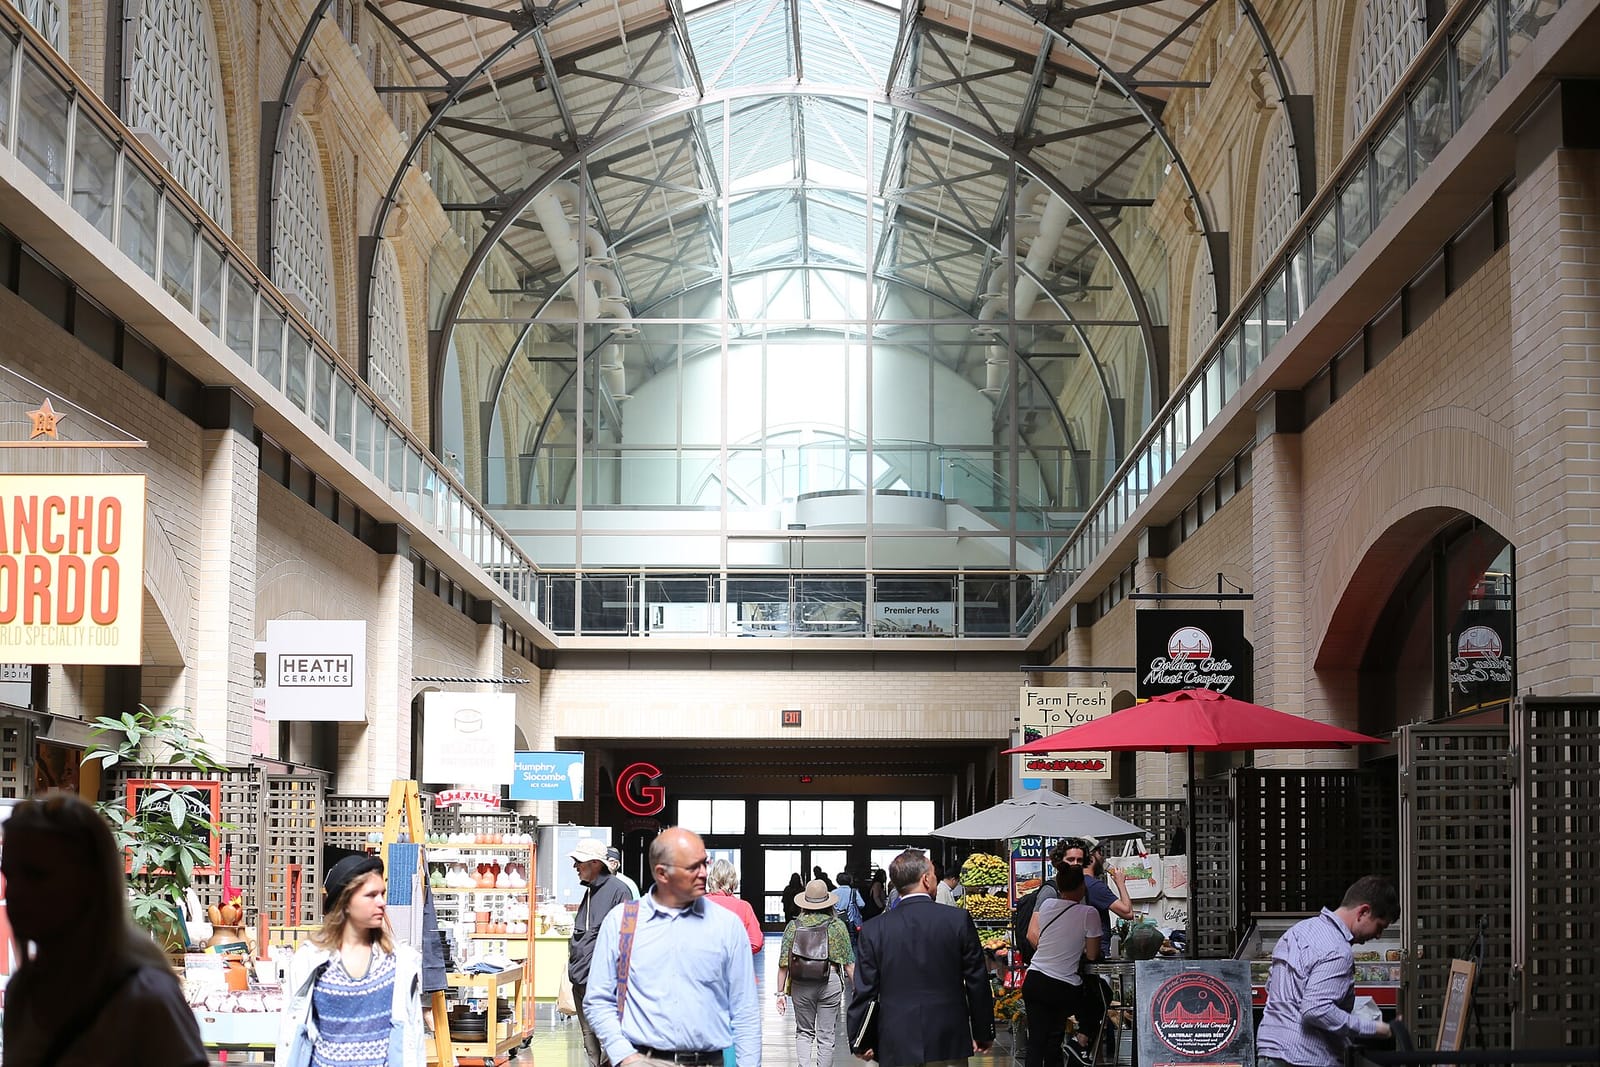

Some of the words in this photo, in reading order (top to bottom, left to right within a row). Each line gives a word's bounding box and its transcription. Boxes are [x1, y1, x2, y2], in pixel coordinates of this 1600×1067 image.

[884, 606, 915, 614] Premier
[917, 606, 939, 614] Perks
[25, 626, 86, 647] SPECIALTY
[88, 627, 119, 647] FOOD
[283, 659, 348, 672] HEATH
[1150, 652, 1197, 671] Golden
[1199, 657, 1232, 673] Gate
[283, 675, 348, 683] CERAMICS
[1143, 669, 1183, 685] Meat
[1183, 670, 1235, 693] Company
[1027, 692, 1062, 706] Farm
[1066, 691, 1106, 706] Fresh
[784, 711, 800, 724] EXIT
[1039, 708, 1061, 723] To
[1064, 709, 1094, 723] You
[514, 762, 556, 773] Humphry
[522, 771, 567, 781] Slocombe
[616, 762, 666, 816] G
[1021, 838, 1042, 846] BUY
[1021, 849, 1042, 857] BUY
